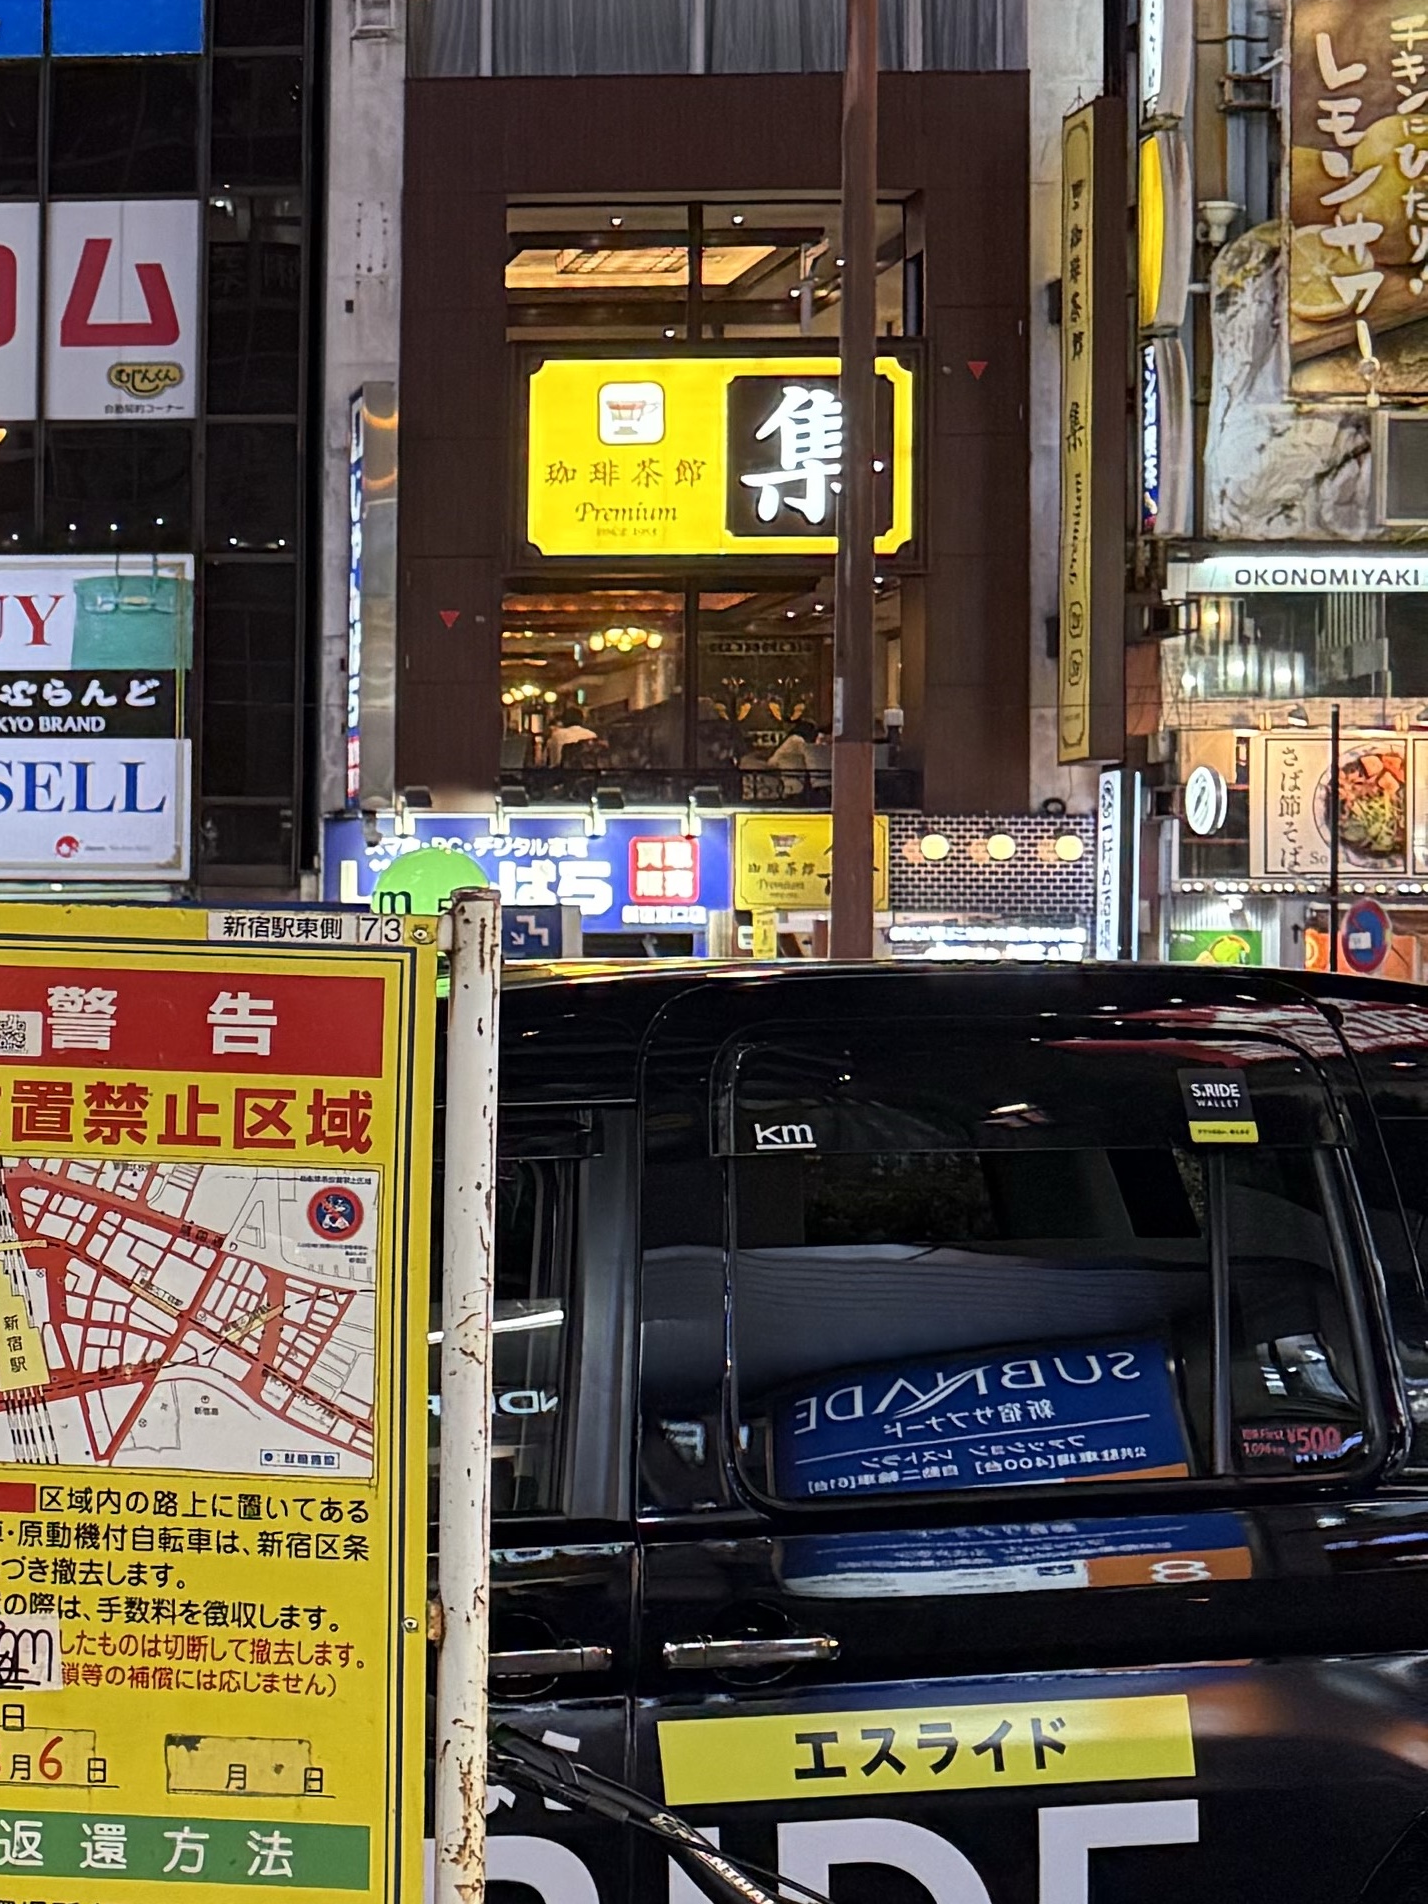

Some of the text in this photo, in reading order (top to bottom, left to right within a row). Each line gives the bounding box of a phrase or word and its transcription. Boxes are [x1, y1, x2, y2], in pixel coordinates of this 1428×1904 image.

[1315, 31, 1385, 361] レモンサワー
[740, 385, 844, 524] 集
[544, 458, 709, 488] 珈琲茶館
[575, 501, 679, 524] Premium
[1234, 566, 1421, 587] OKONOMIYAKI
[38, 714, 107, 734] BRAND
[1276, 745, 1302, 869] さば節そば
[222, 916, 403, 943] 新宿駅東側 73
[46, 985, 278, 1057] 警告
[1190, 1083, 1241, 1099] S.RIDE
[1195, 1098, 1240, 1109] WALLET
[754, 1122, 814, 1146] km
[3, 1314, 29, 1374] 新宿駅
[39, 1483, 370, 1525] 区域内の路上に置いてある
[793, 1713, 1070, 1783] エスライド
